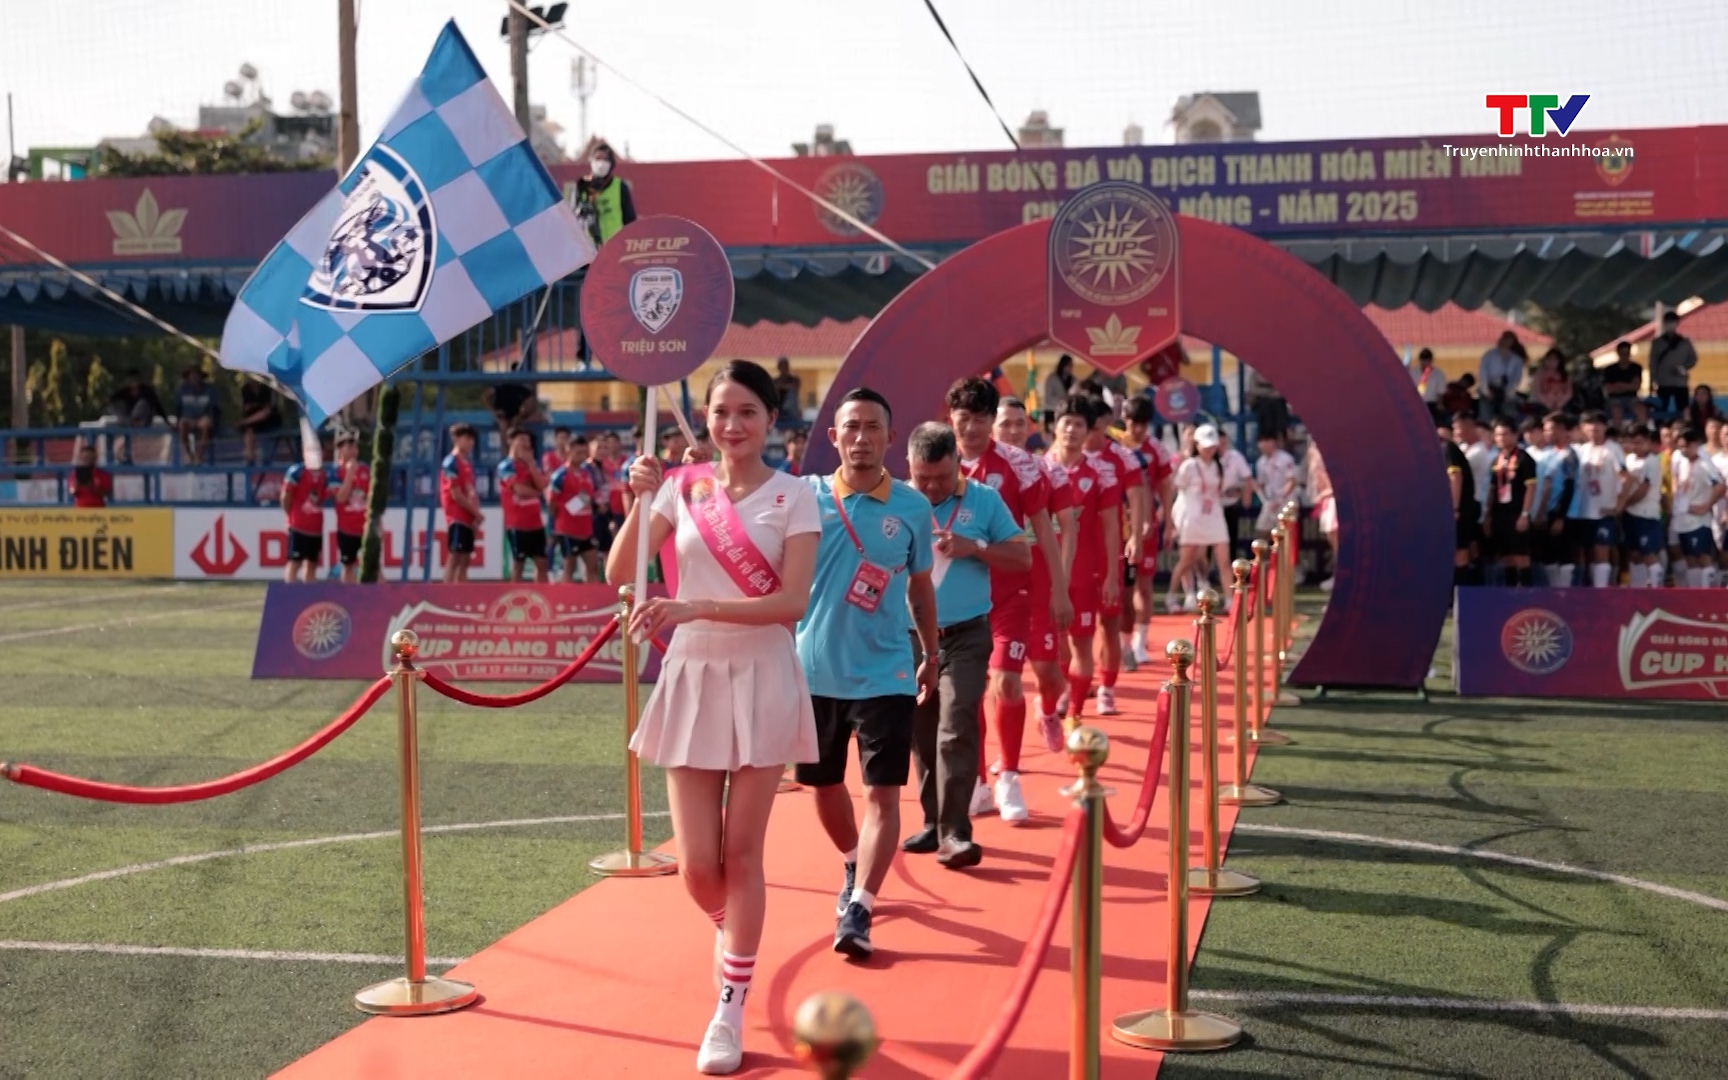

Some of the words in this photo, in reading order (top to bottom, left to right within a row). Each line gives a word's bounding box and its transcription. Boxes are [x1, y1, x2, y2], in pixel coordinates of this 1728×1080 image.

[926, 157, 980, 194] GIẢI
[986, 158, 1058, 193] BÓNG
[1064, 155, 1100, 189] ĐÁ
[1107, 154, 1143, 184] VÔ
[1151, 155, 1216, 192] ĐỊCH
[1223, 153, 1312, 184] THANH
[1320, 147, 1376, 182] HÓA
[1384, 140, 1451, 180] MIỀN
[1460, 148, 1522, 177] NAM
[1278, 189, 1339, 224] NĂM
[1346, 191, 1418, 222] 2025
[657, 237, 690, 250] CUP
[1090, 241, 1139, 257] CUP
[621, 338, 655, 355] TRIỆU
[659, 338, 687, 353] SƠN
[59, 523, 134, 570] ĐIỂN
[417, 639, 453, 658] UP
[458, 636, 549, 658] HOÀNG
[1640, 651, 1705, 675] CUP
